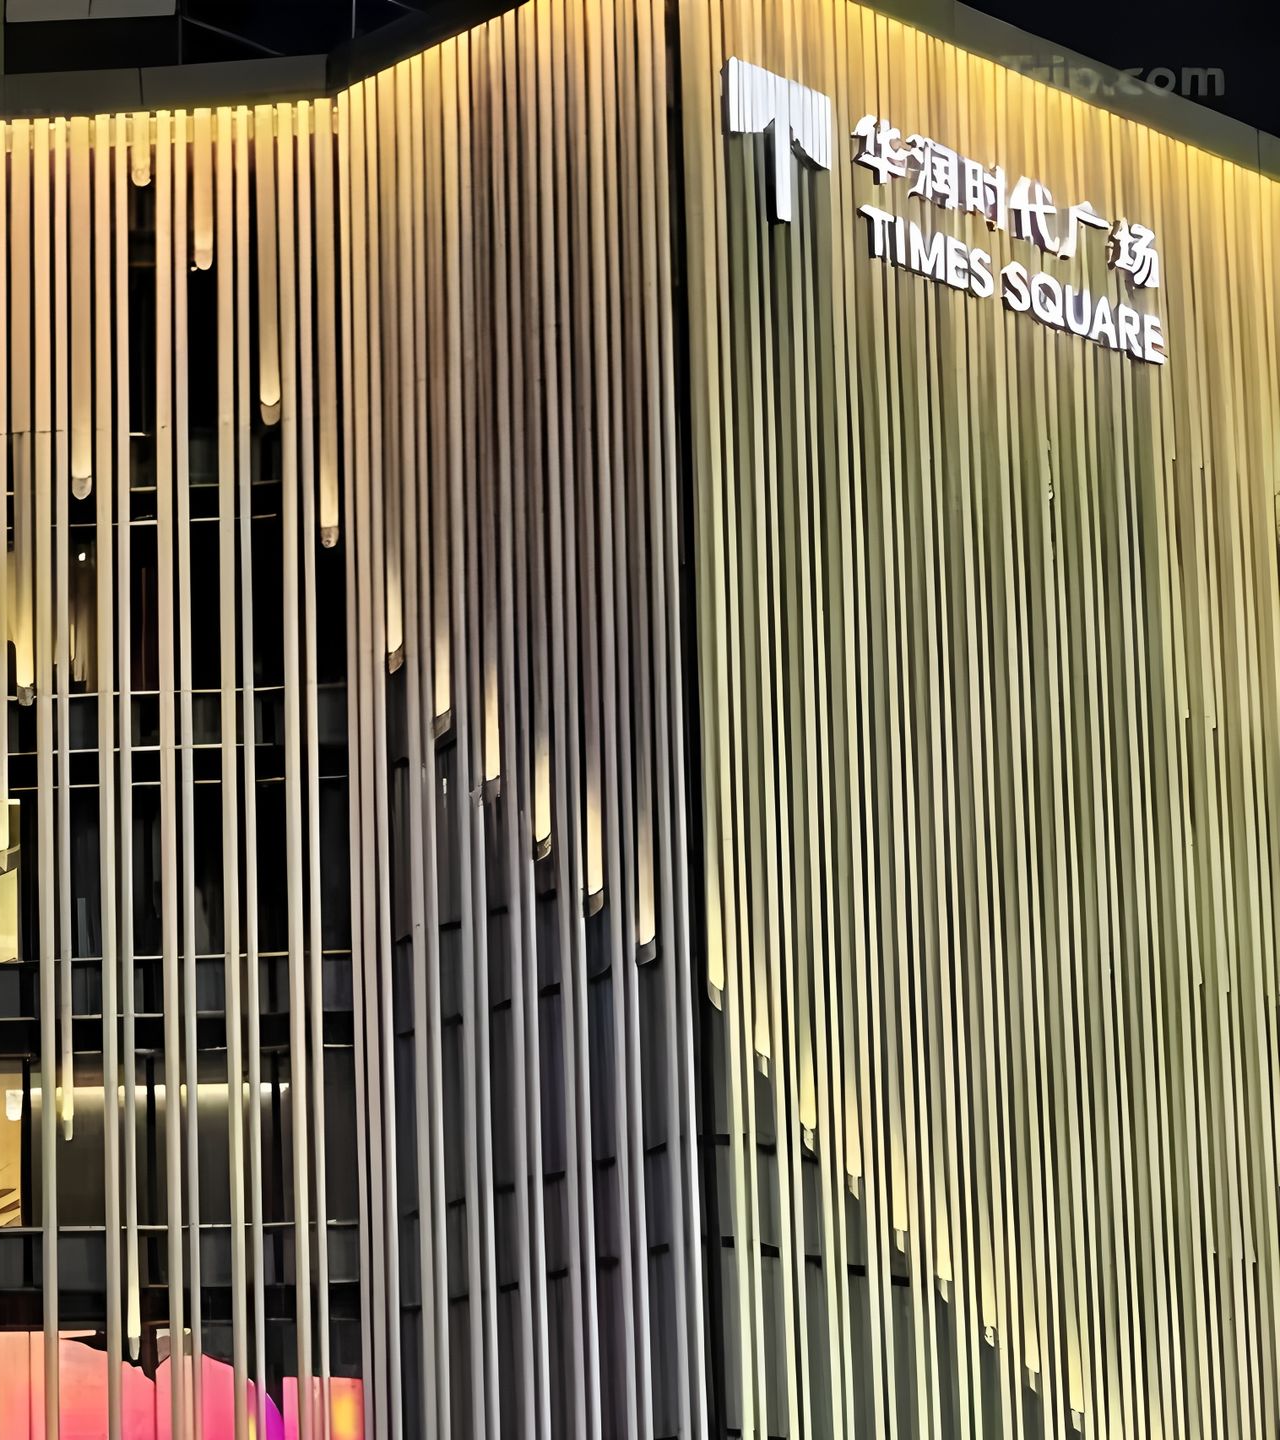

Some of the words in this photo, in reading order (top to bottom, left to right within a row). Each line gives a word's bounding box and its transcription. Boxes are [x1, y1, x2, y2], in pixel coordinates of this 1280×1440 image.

[850, 114, 1162, 289] 华润时代广场
[858, 203, 995, 299] TIMES
[1001, 261, 1168, 367] SQUARE
